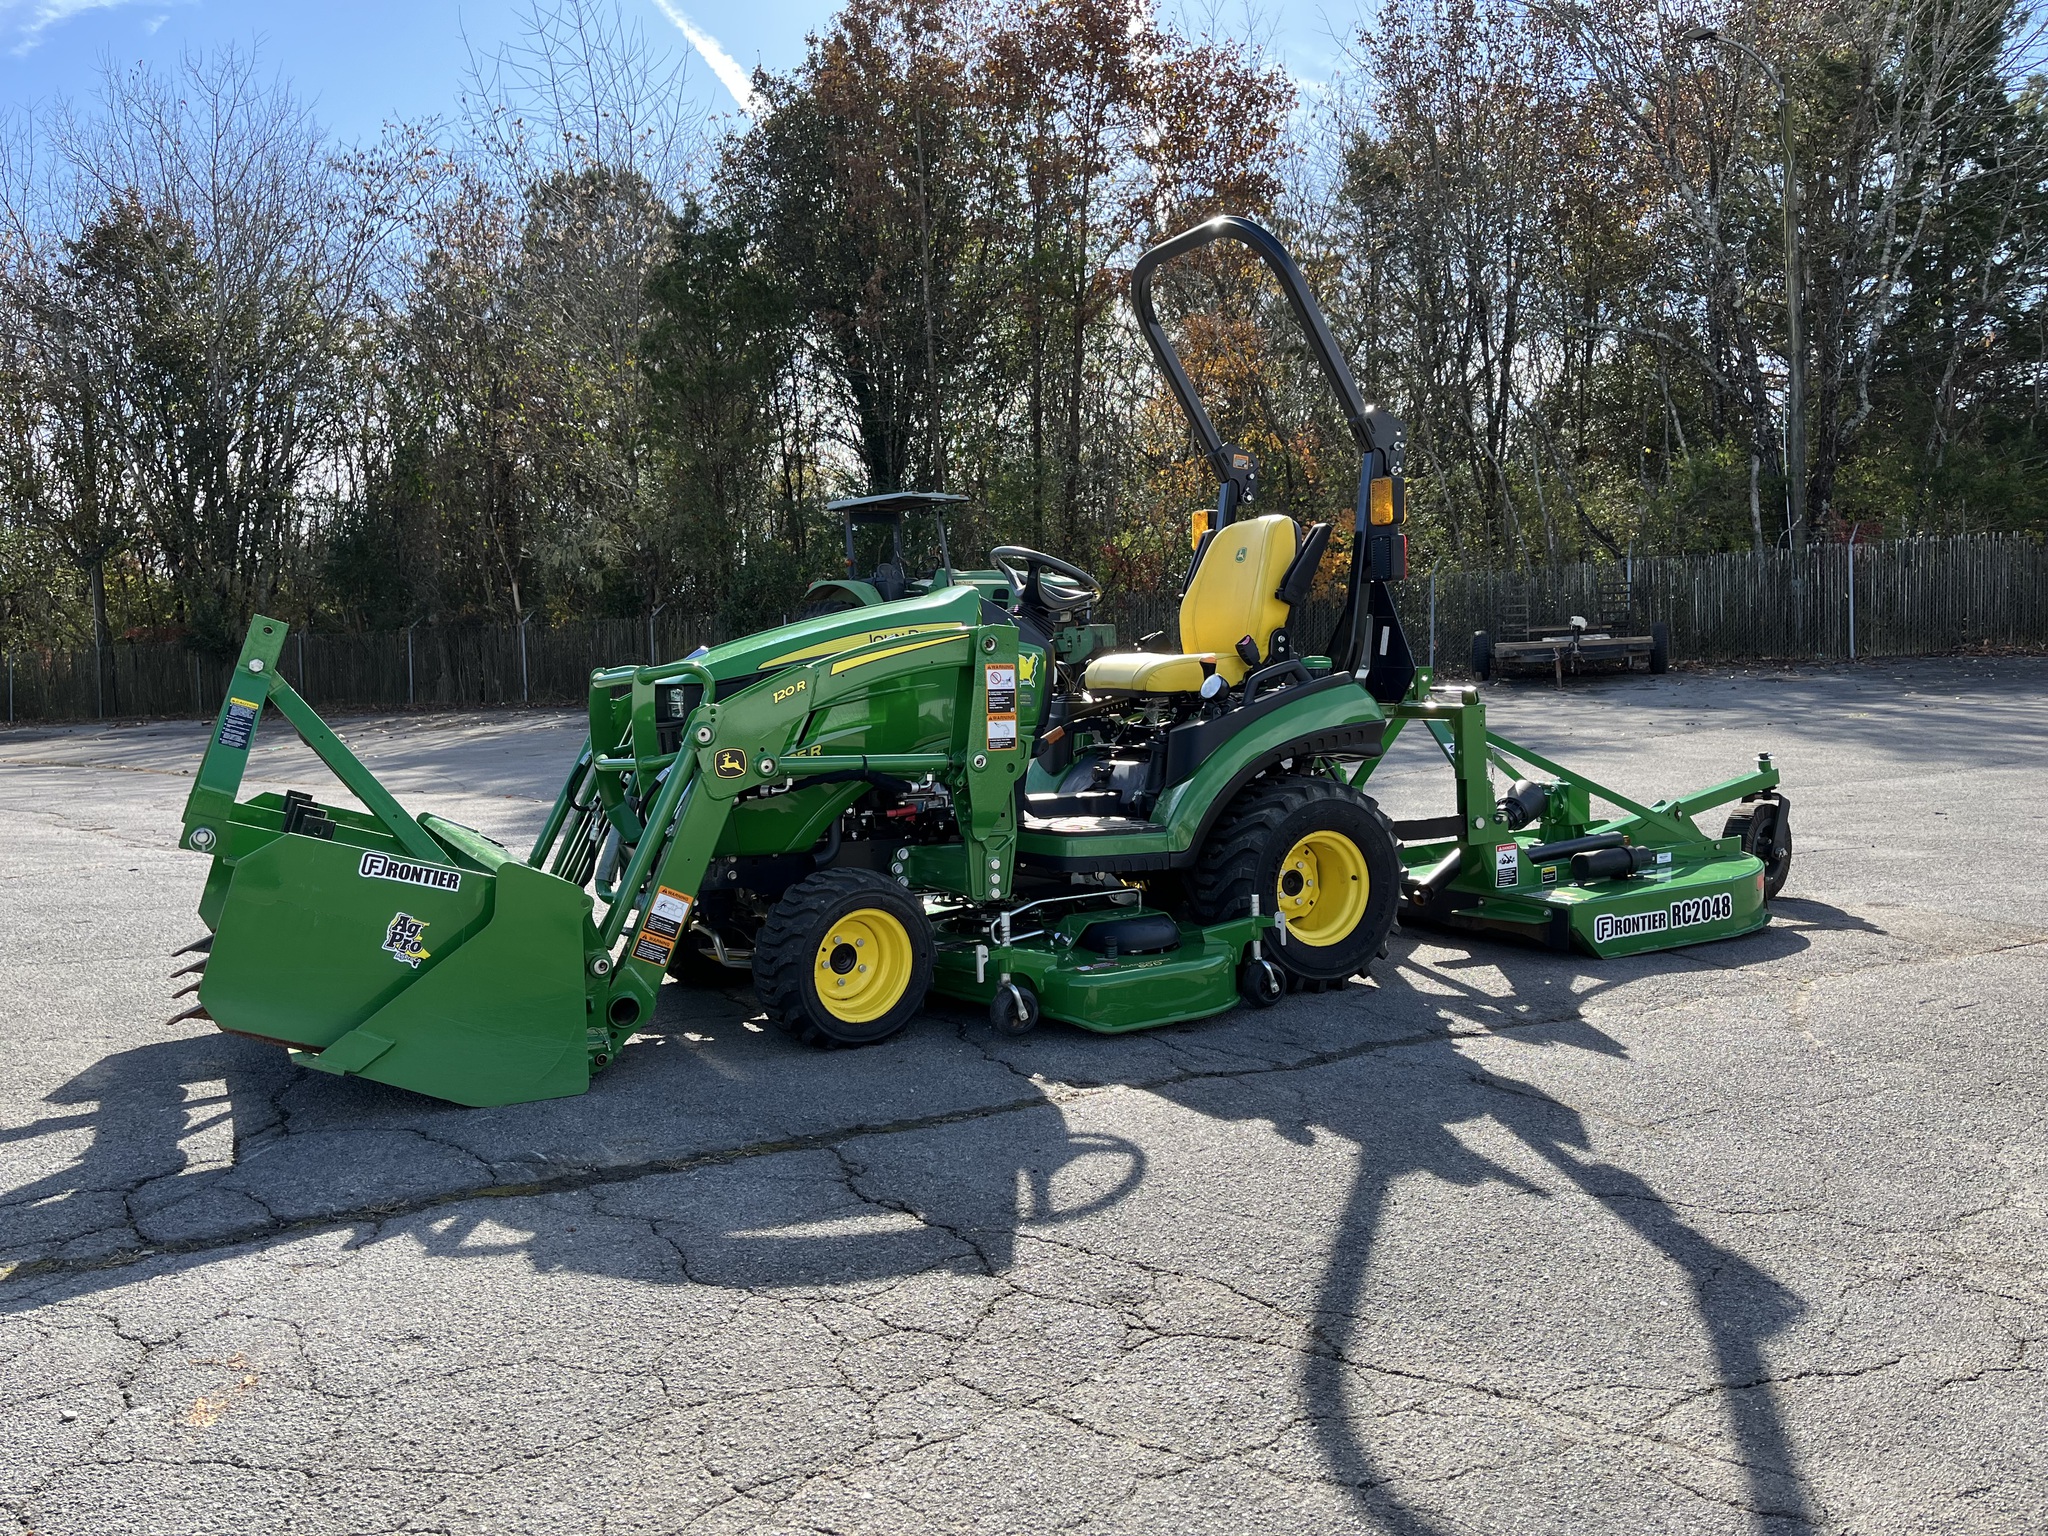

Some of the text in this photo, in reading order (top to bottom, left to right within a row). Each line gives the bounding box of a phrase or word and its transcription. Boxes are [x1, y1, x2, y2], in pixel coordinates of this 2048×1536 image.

[772, 680, 806, 704] 120 R
[361, 853, 460, 890] FRONTIER
[667, 890, 689, 902] WARNING
[391, 916, 421, 938] Ag
[1596, 895, 1731, 941] FRONTIER RC2048
[386, 931, 422, 953] Pro
[649, 935, 671, 947] WARNING
